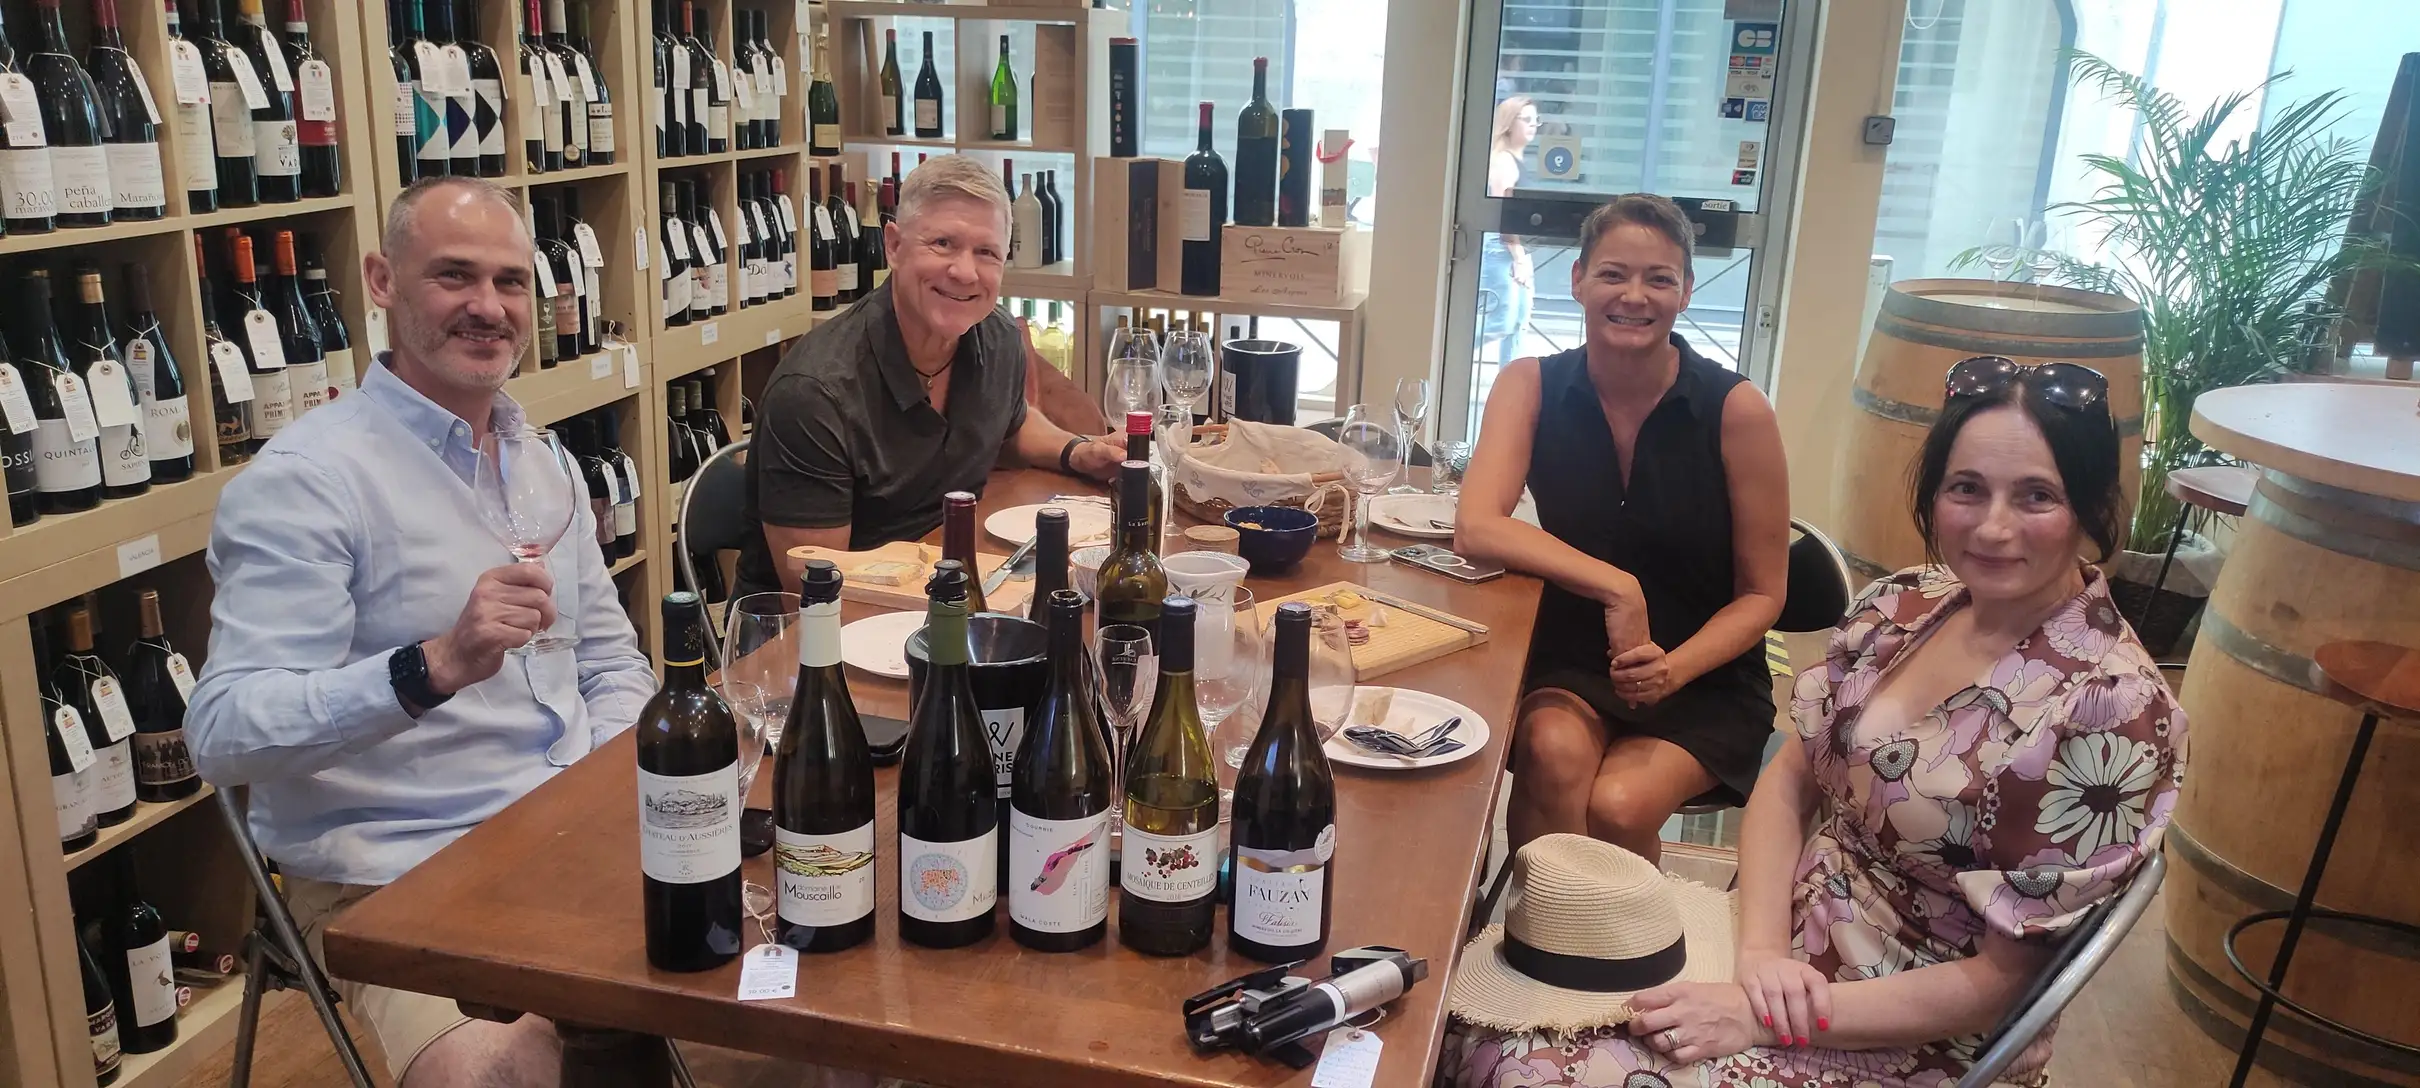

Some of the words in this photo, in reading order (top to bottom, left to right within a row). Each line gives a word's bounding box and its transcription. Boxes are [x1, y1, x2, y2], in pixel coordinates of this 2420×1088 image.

[64, 186, 97, 199] peña
[1703, 200, 1728, 210] Sortie
[1254, 270, 1305, 280] MINERVOIS
[784, 880, 842, 901] Mouscaillo
[1163, 882, 1175, 891] DE
[1039, 919, 1061, 927] COSTE
